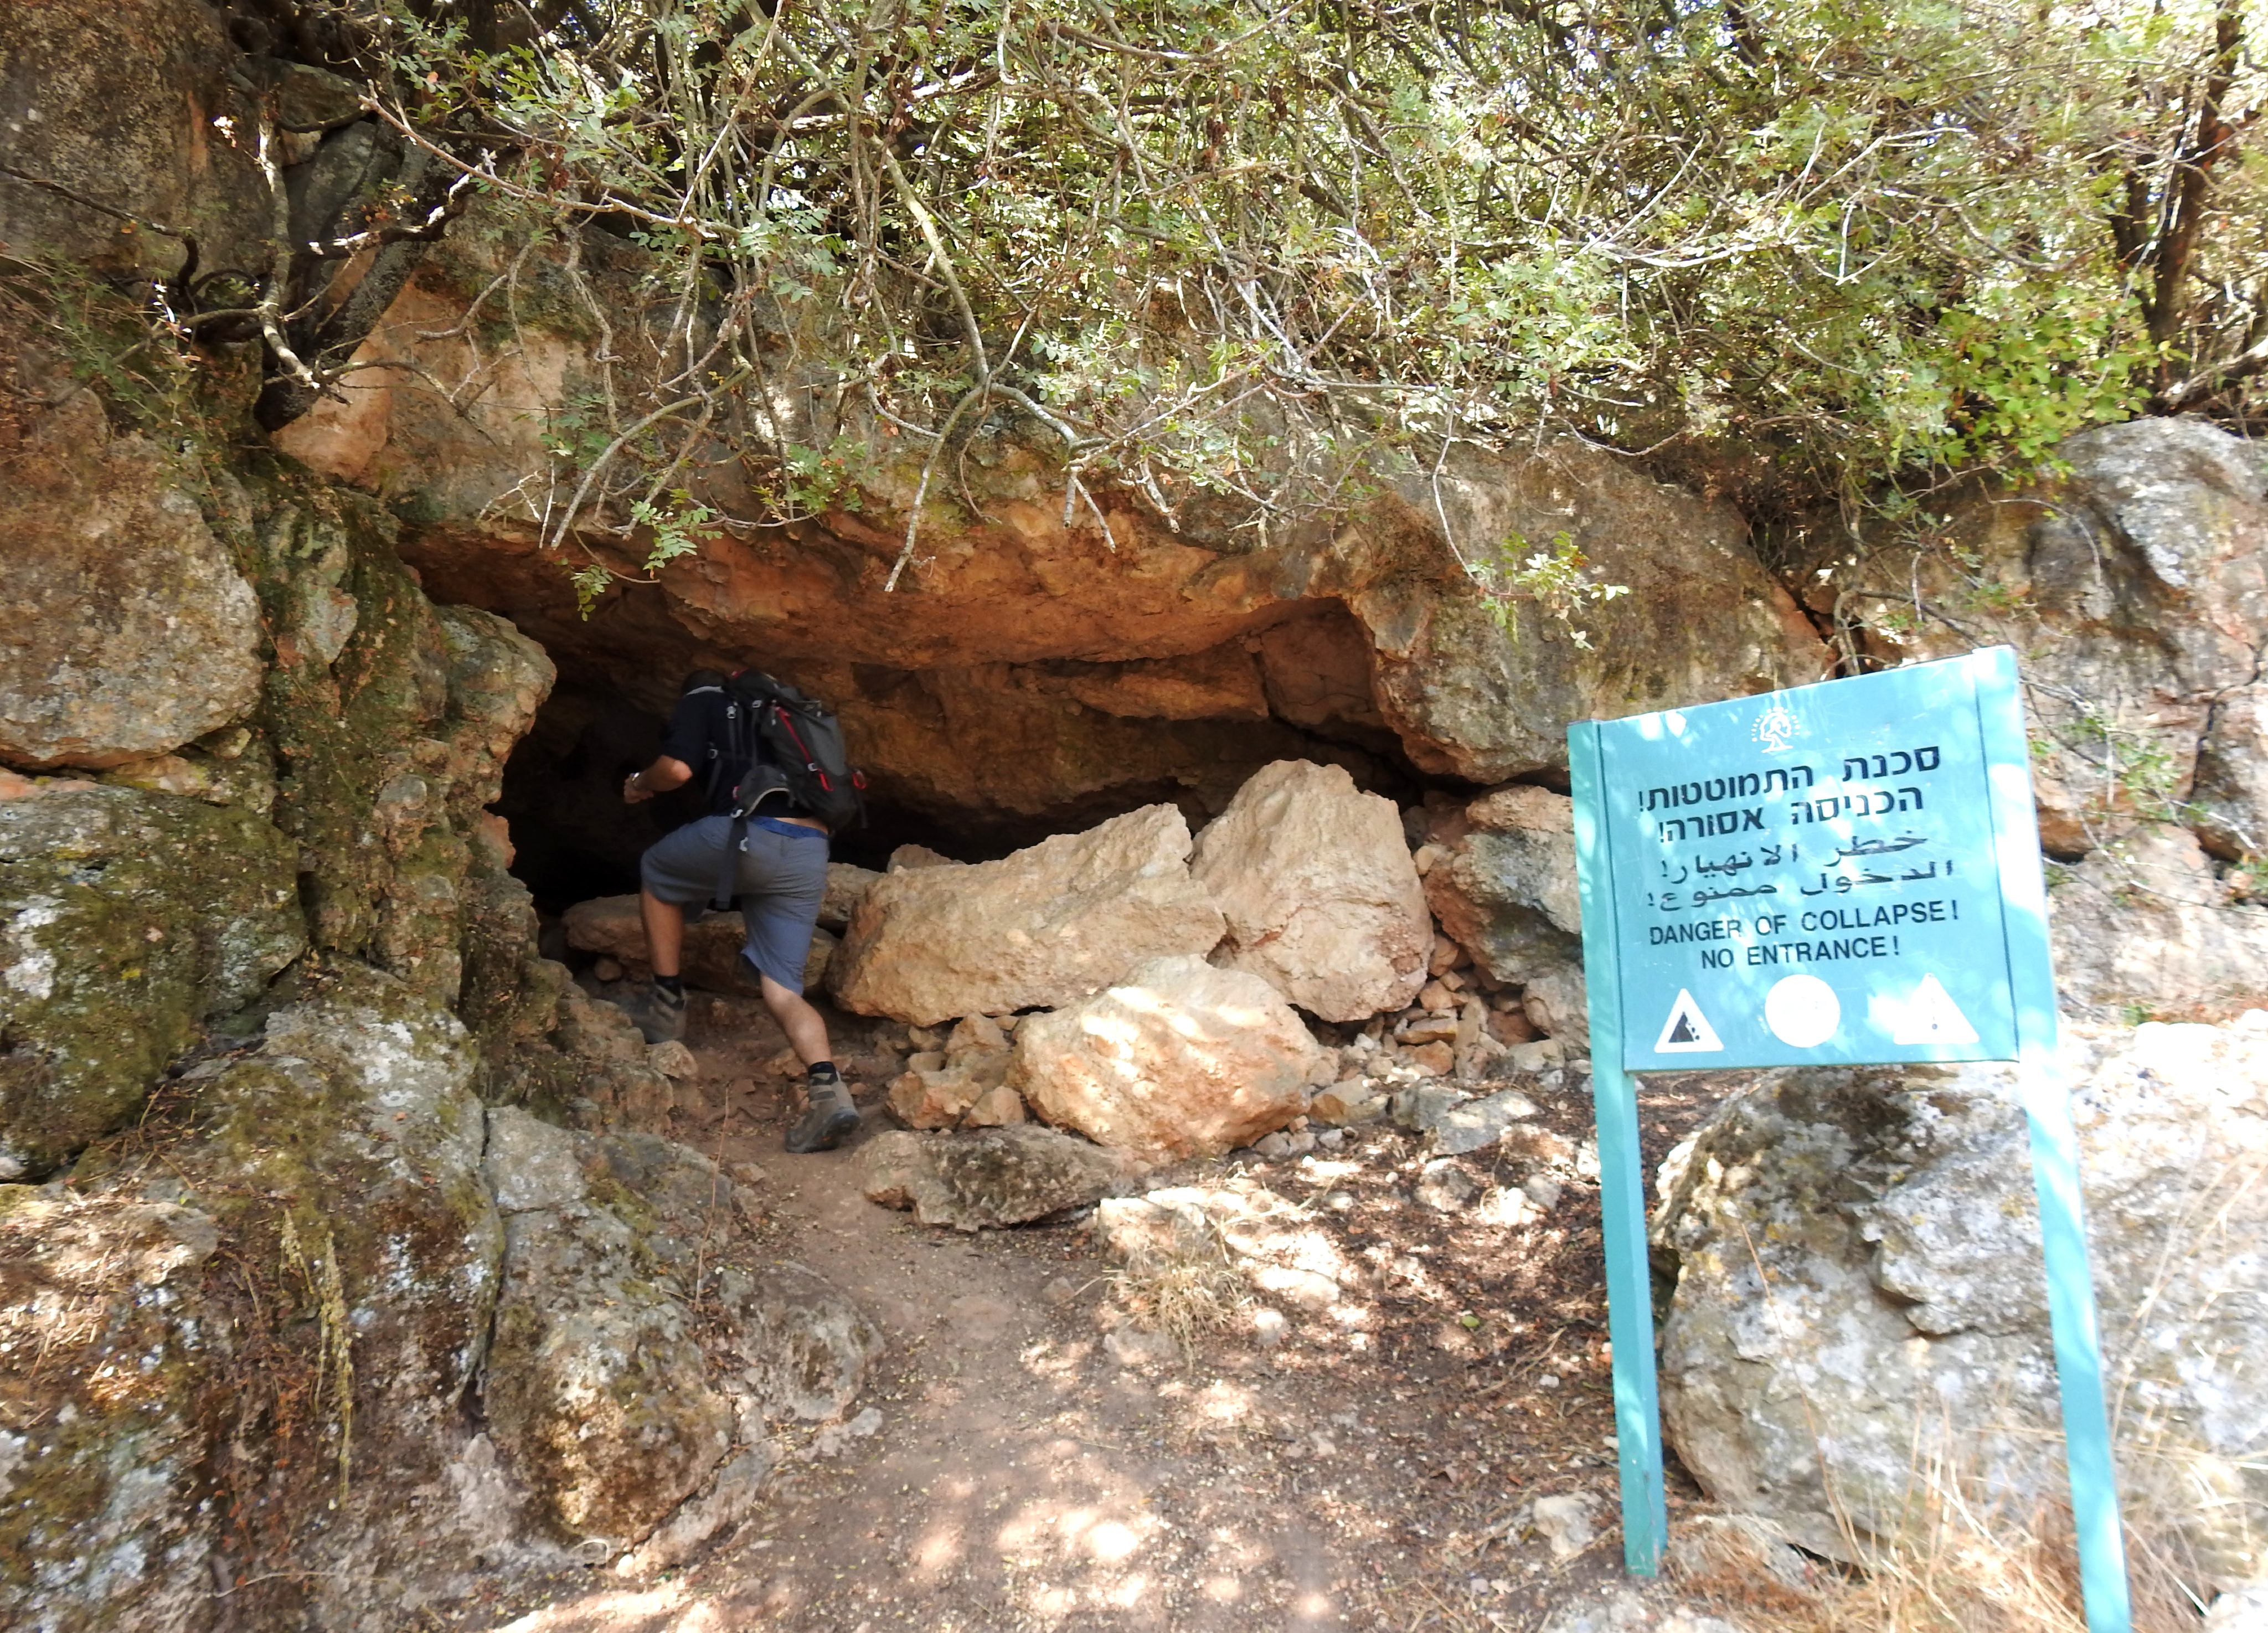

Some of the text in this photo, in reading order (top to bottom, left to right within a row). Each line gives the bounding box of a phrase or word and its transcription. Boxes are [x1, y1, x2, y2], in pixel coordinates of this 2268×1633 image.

[1637, 745, 1940, 812] סכנת התמוטטות!
[1658, 787, 1923, 843] הכניסה אסורה!
[1823, 830, 1928, 867] خطر
[1800, 859, 1953, 895] الدخول
[1650, 899, 1959, 945] DANGER OF COLLAPSE!
[1701, 935, 1900, 969] NO ENTRANCE!
